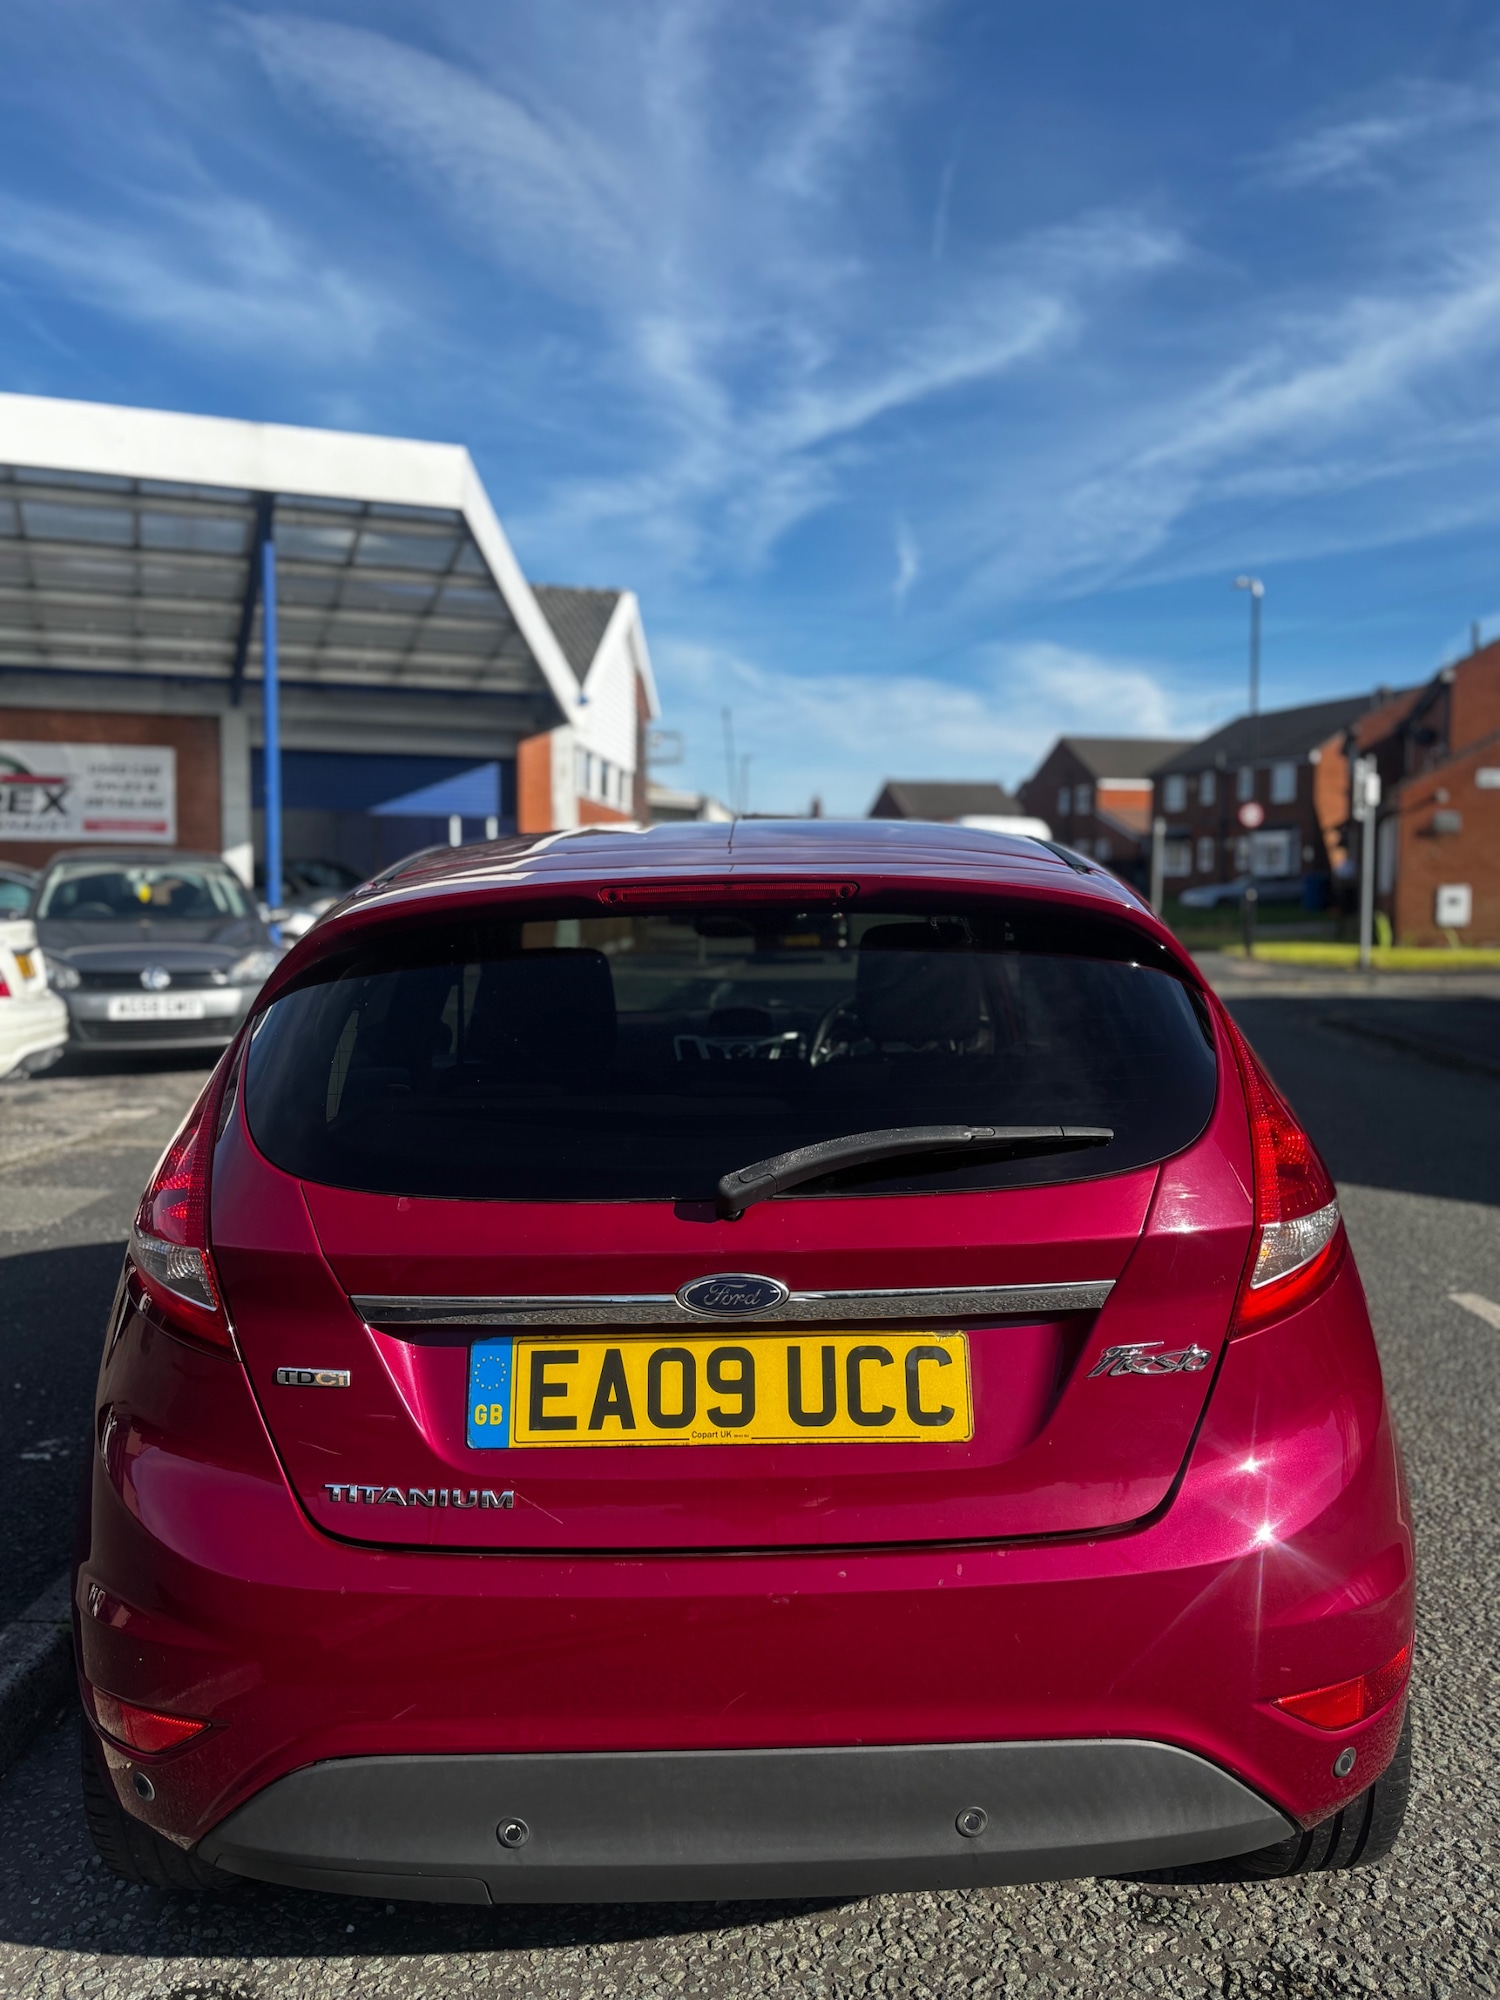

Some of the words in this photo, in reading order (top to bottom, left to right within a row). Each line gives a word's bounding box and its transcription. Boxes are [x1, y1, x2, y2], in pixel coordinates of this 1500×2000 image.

[704, 1283, 761, 1305] Ford
[529, 1346, 755, 1431] EA09
[787, 1345, 955, 1427] UCC
[474, 1404, 503, 1426] GB
[691, 1430, 718, 1439] Copart
[720, 1430, 732, 1438] UK
[324, 1483, 515, 1509] TITANIUM
